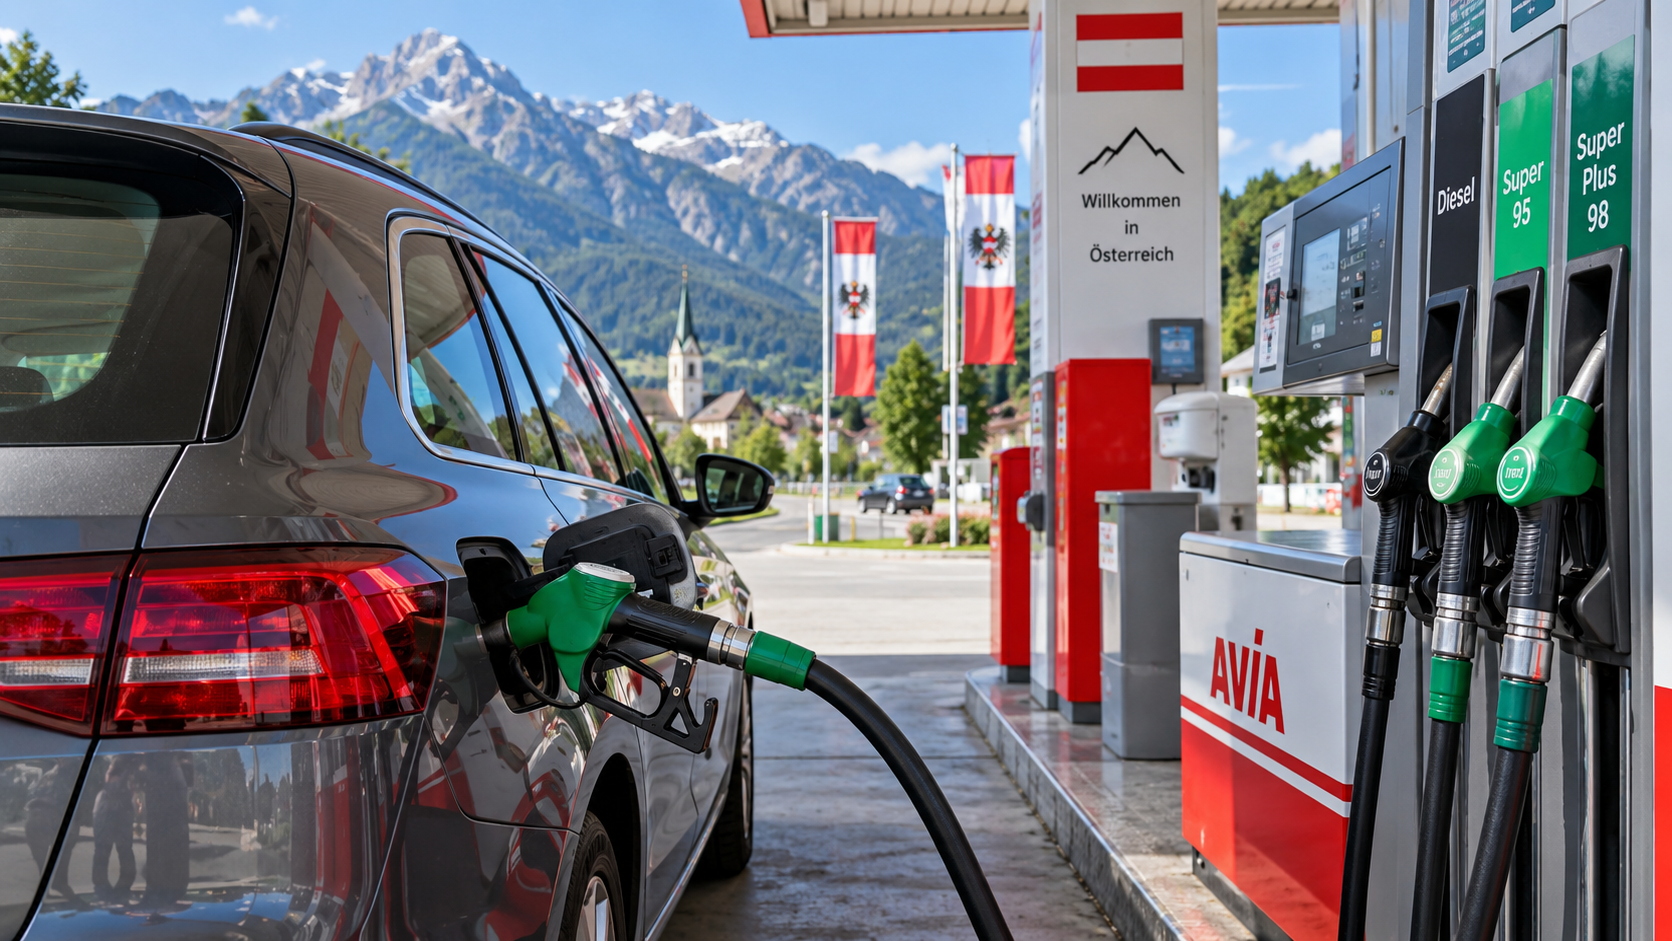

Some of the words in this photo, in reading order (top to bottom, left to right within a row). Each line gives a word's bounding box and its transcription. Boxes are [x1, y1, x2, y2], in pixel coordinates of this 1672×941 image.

[1576, 122, 1625, 160] Super
[1502, 160, 1545, 195] Super
[1582, 163, 1617, 195] Plus
[1081, 193, 1181, 209] Willkommen
[1437, 176, 1475, 215] Diesel
[1124, 219, 1139, 235] in
[1512, 197, 1531, 229] 95
[1587, 199, 1609, 233] 98
[1089, 243, 1174, 263] Österreich
